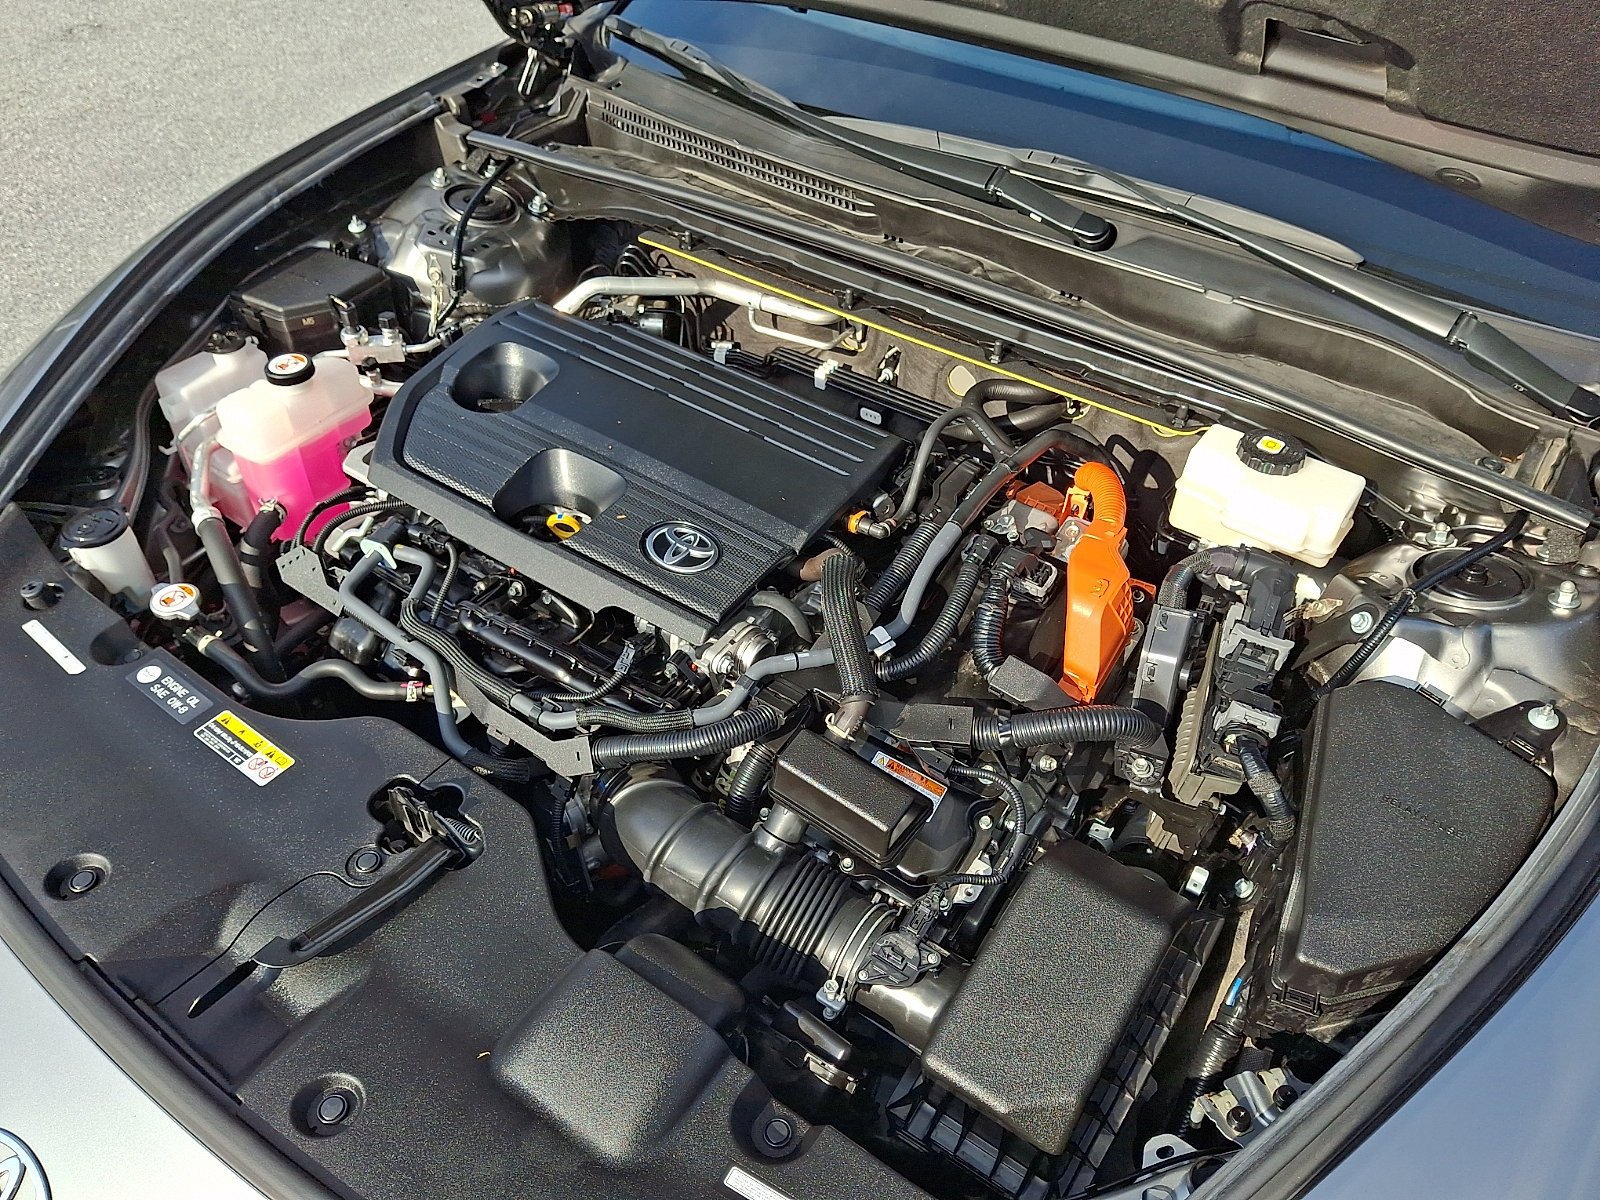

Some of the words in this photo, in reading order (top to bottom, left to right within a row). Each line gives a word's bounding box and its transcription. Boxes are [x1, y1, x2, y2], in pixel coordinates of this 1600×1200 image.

[150, 684, 170, 699] SAE
[161, 676, 190, 698] ENGINE
[186, 696, 200, 709] OIL
